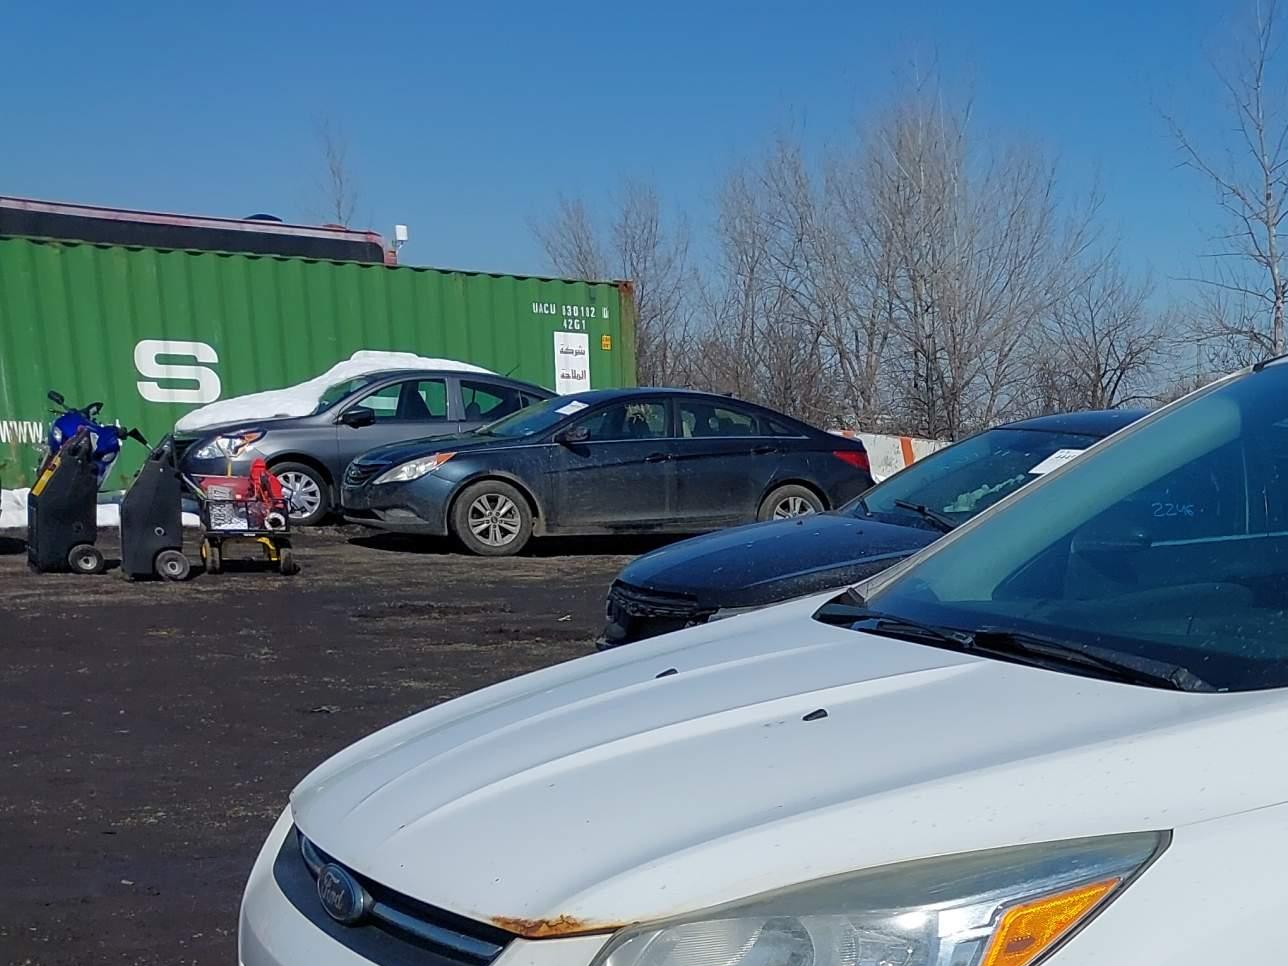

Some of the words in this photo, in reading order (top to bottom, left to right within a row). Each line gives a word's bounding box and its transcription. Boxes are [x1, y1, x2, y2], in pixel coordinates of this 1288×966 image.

[532, 302, 556, 314] UACU
[134, 339, 222, 404] S
[321, 870, 346, 911] Ford
